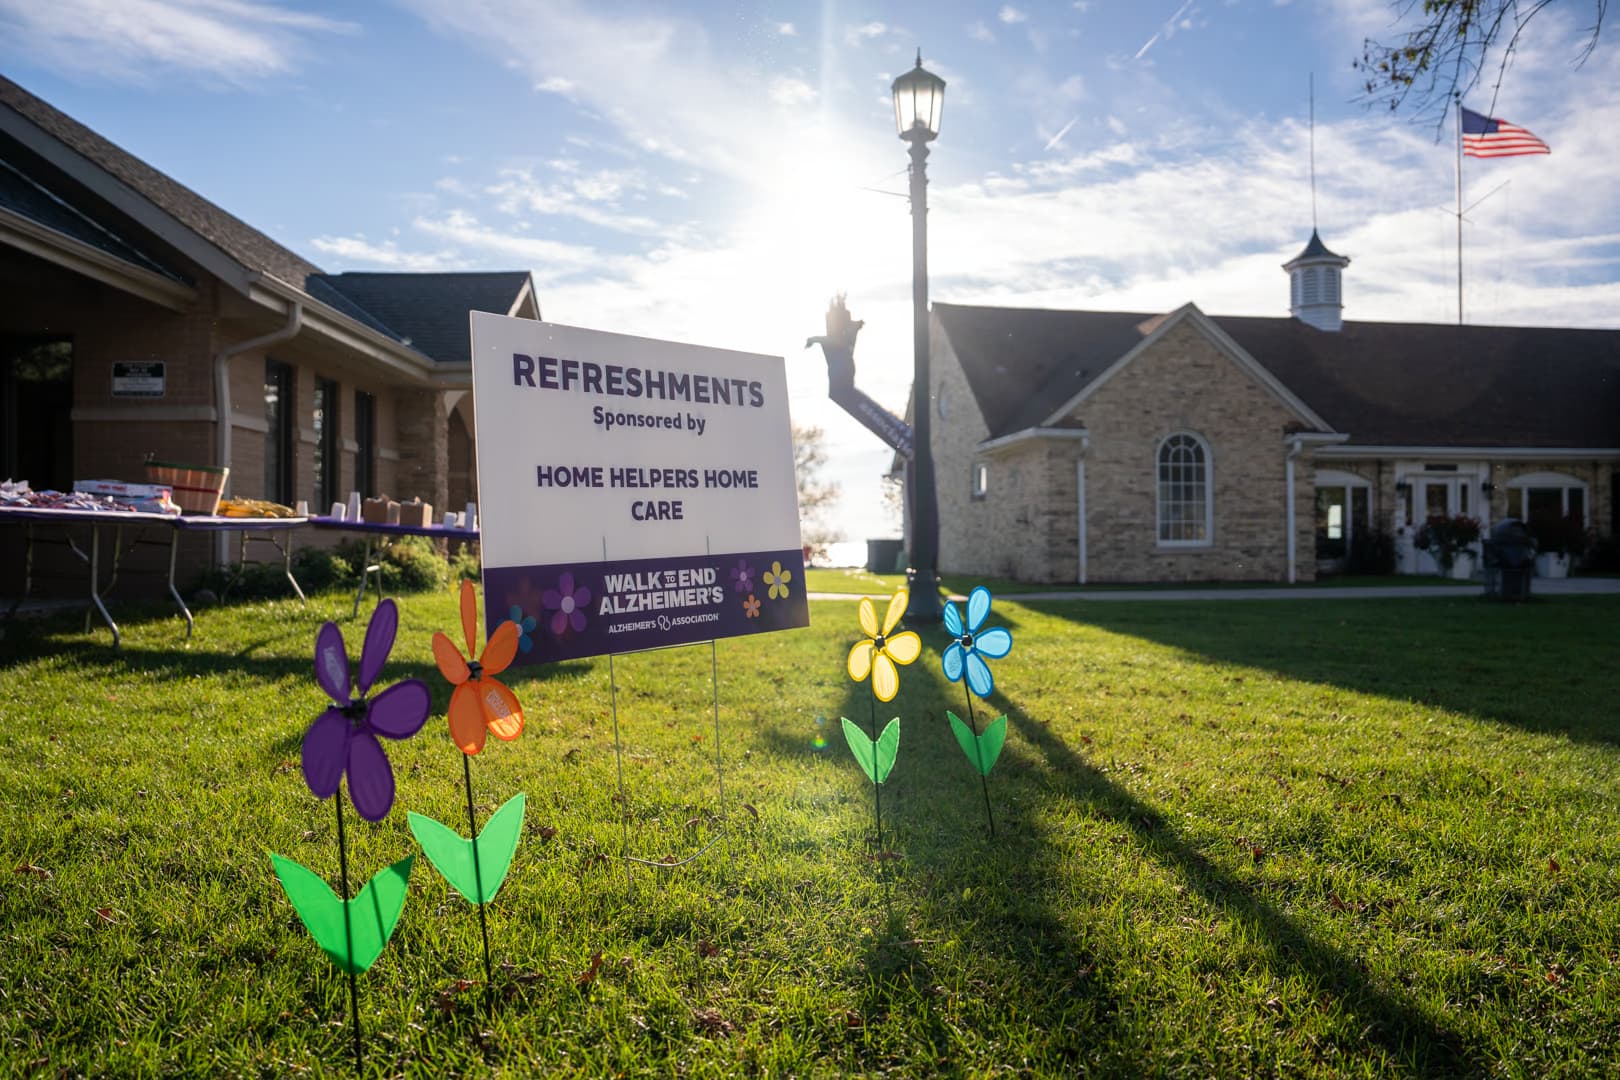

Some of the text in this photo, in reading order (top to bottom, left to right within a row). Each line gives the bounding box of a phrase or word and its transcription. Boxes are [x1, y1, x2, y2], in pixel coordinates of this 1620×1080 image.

[512, 352, 765, 408] REFRESHMENTS
[593, 405, 706, 436] Sponsored by
[536, 465, 759, 489] HOME HELPERS HOME
[631, 500, 684, 521] CARE
[604, 572, 662, 593] WALK
[678, 568, 717, 587] END
[599, 586, 724, 616] ALZHEIMER'S
[608, 613, 719, 634] ALZHEIMER'S ASSOCIATION
